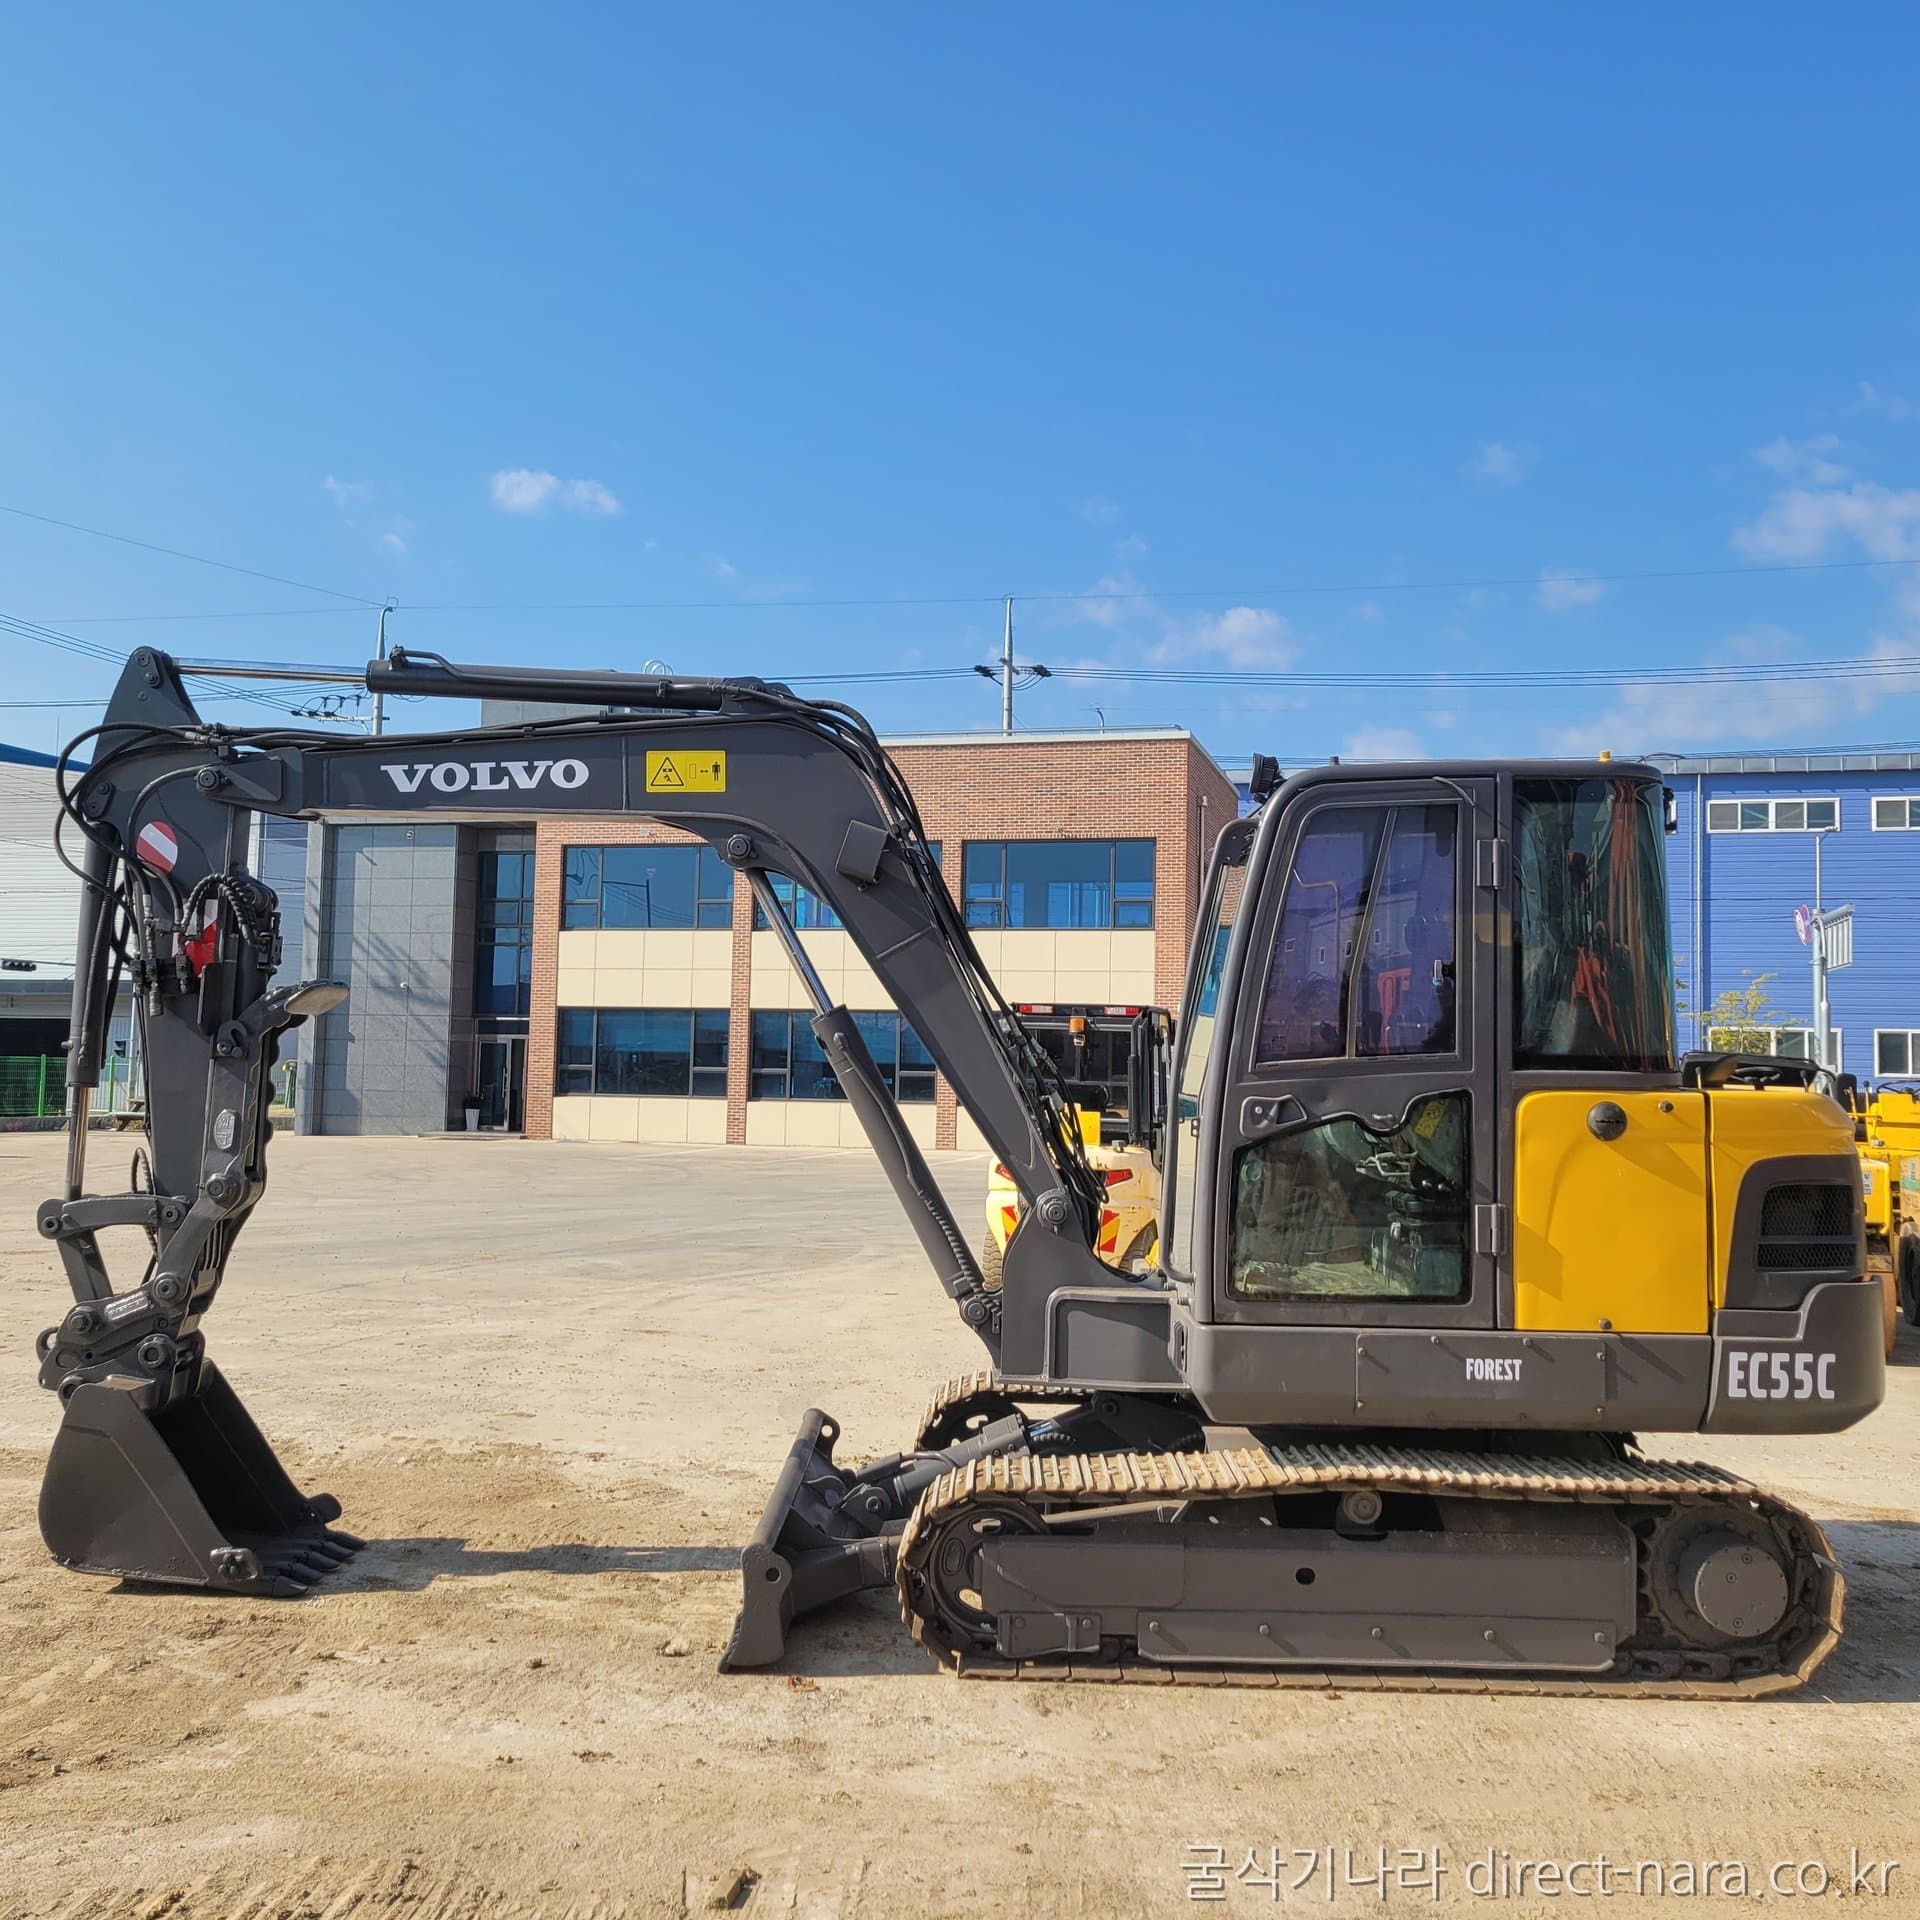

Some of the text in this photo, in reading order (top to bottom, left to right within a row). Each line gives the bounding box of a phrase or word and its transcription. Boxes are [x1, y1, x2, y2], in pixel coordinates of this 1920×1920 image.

[380, 758, 590, 793] VOLVO
[1465, 1357, 1523, 1382] FOREST
[1728, 1351, 1836, 1400] EC55C
